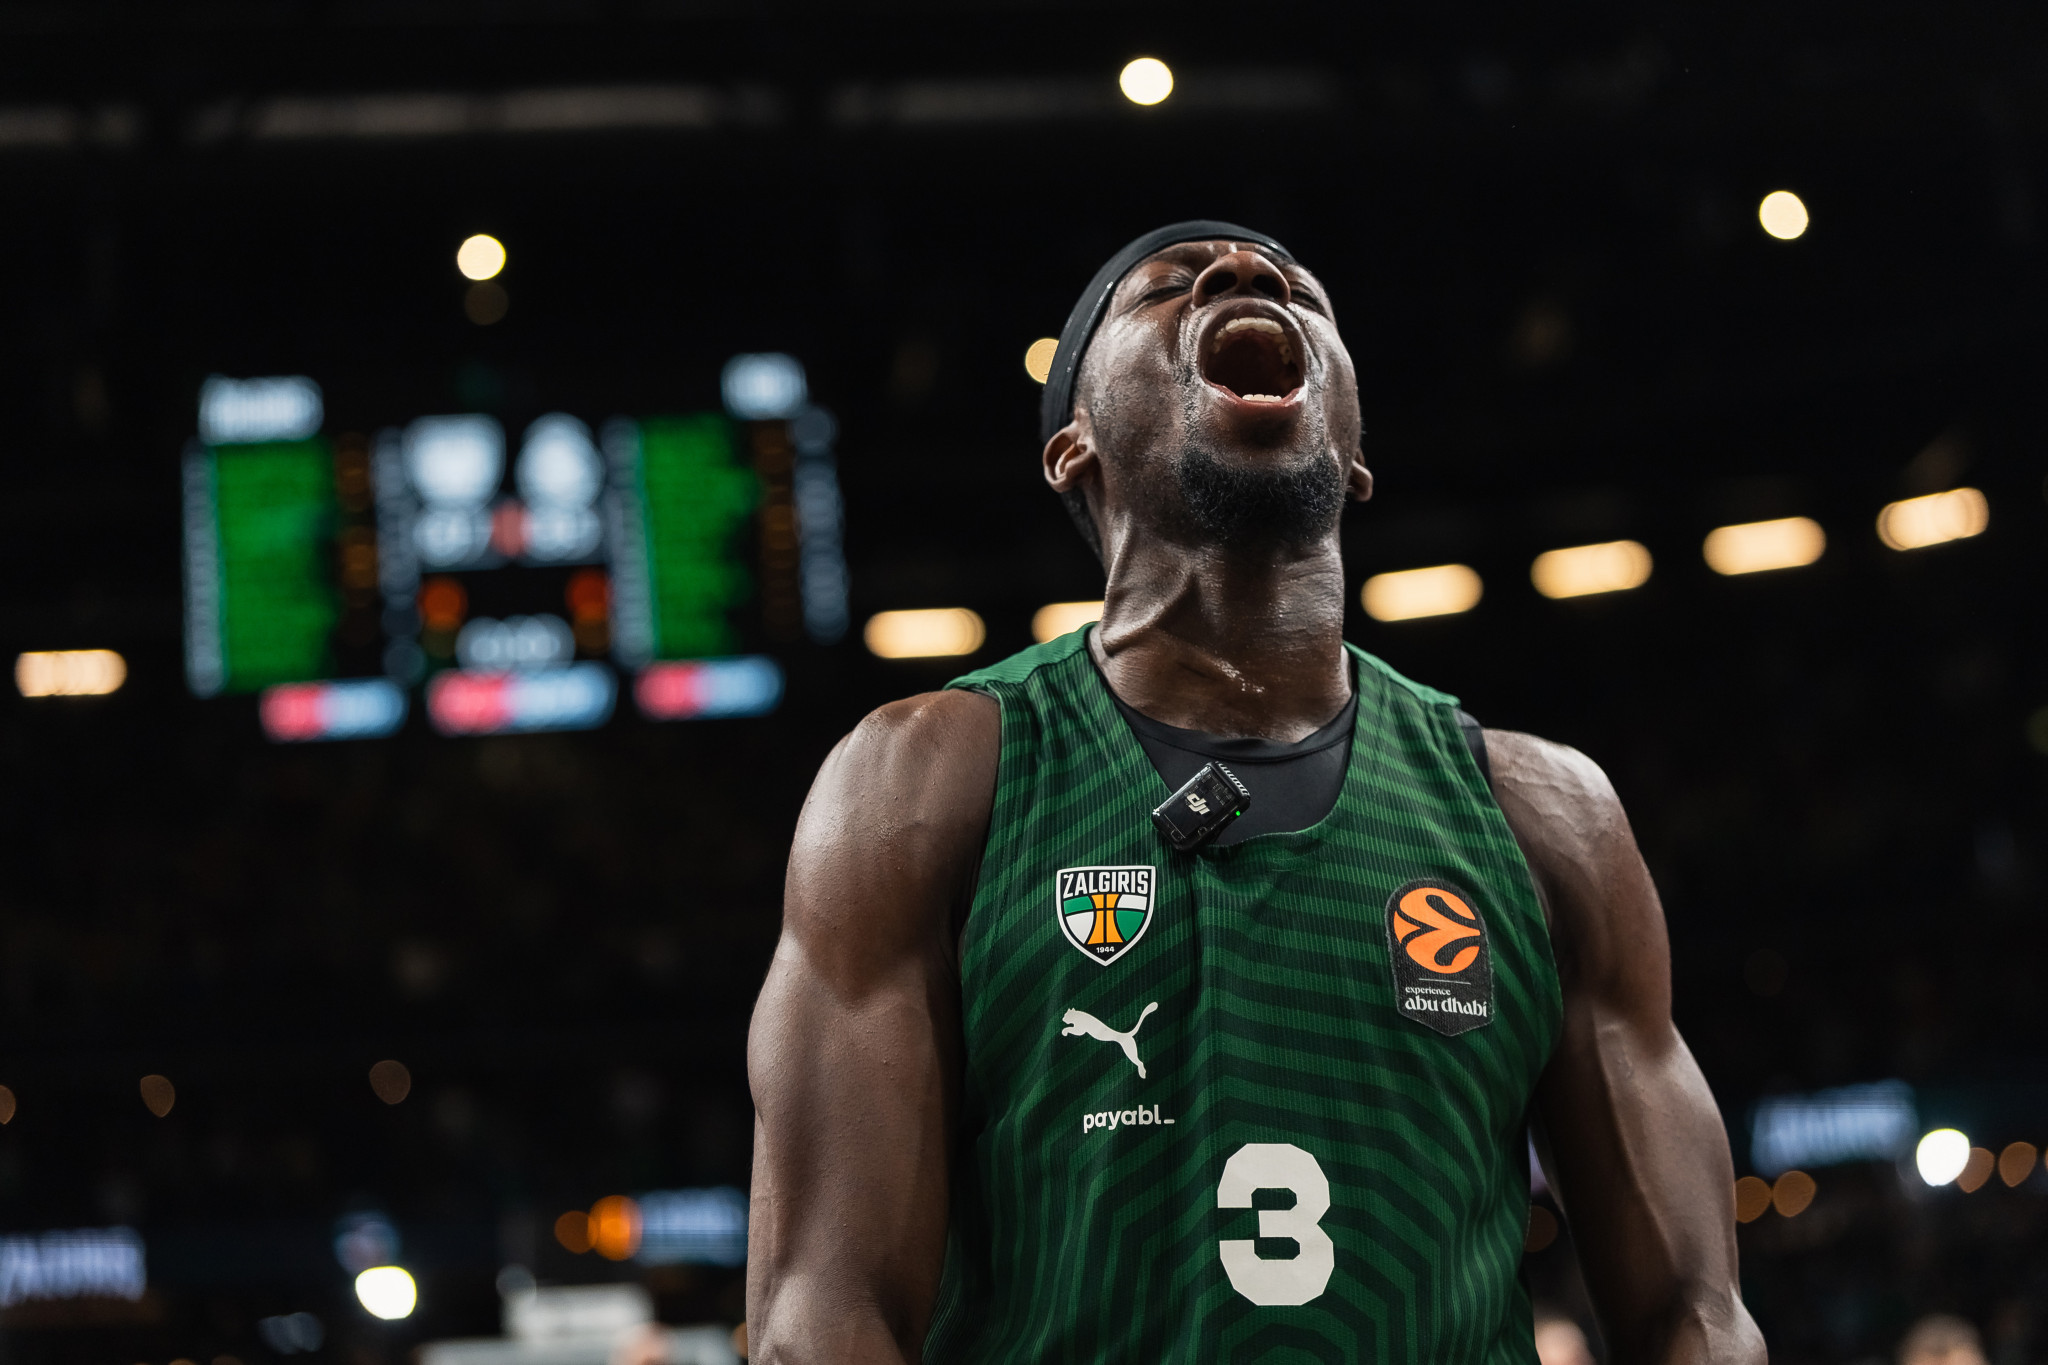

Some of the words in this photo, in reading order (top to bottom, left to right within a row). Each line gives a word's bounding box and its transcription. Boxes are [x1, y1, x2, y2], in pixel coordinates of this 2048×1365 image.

[1405, 986, 1452, 996] experience
[1405, 995, 1439, 1011] abu
[1441, 997, 1488, 1018] dhabi
[1217, 1143, 1335, 1306] 3
